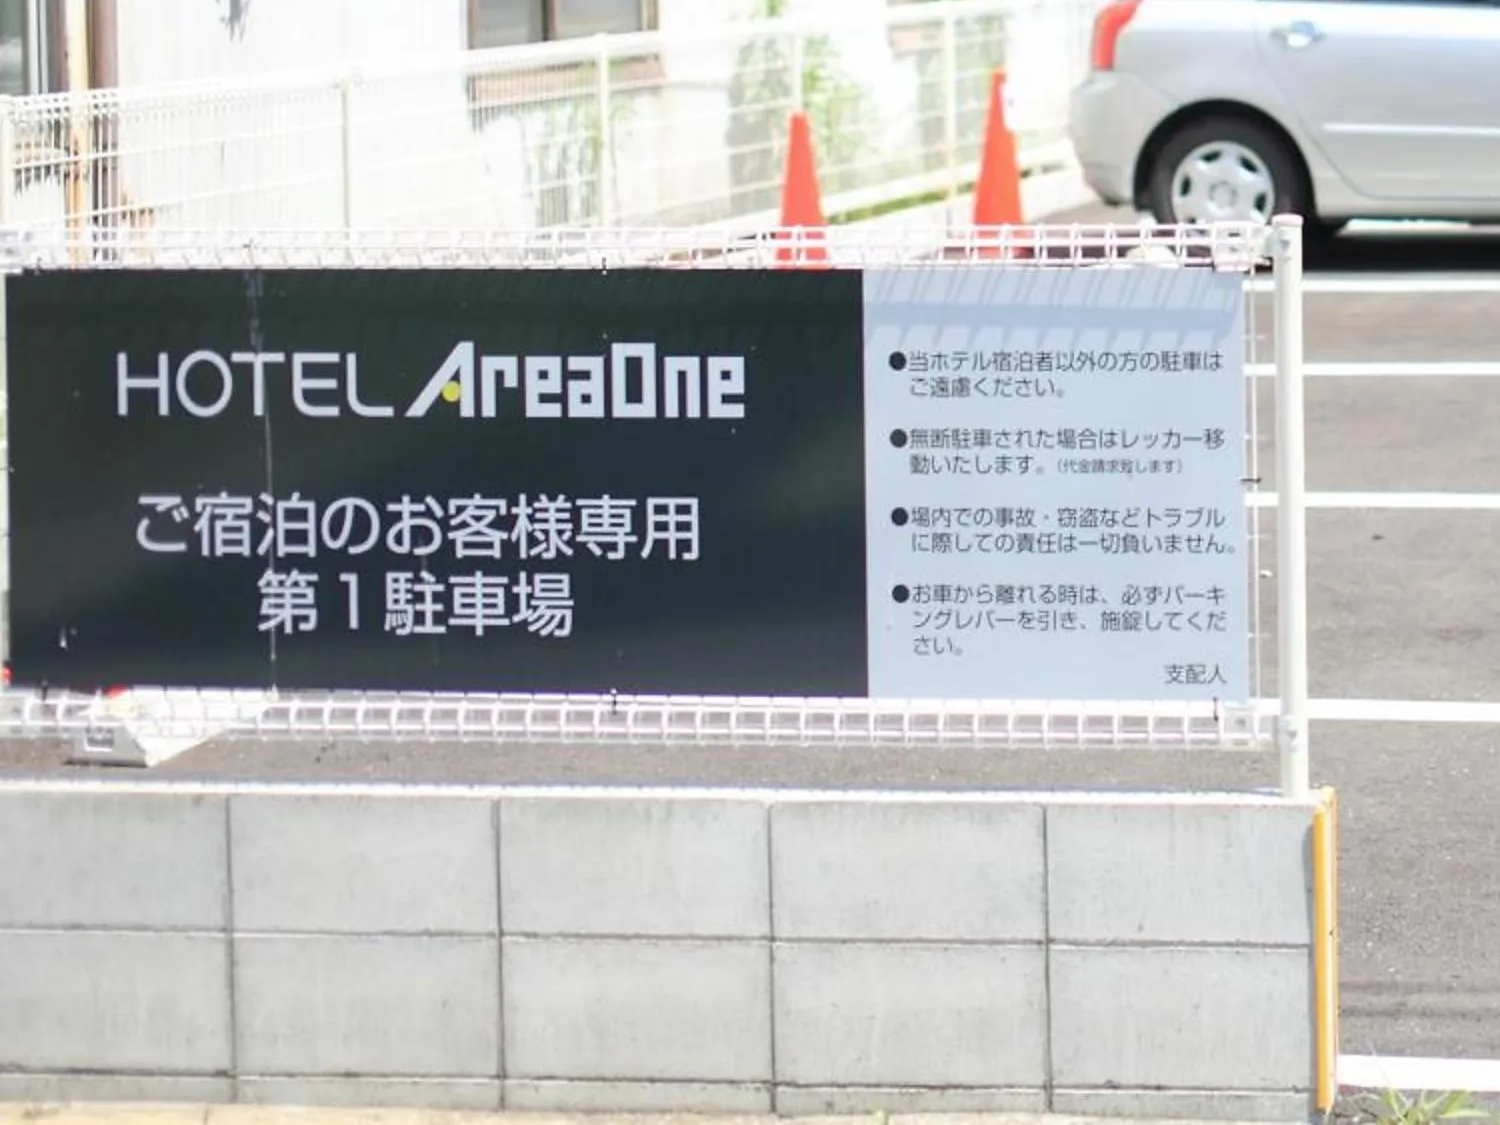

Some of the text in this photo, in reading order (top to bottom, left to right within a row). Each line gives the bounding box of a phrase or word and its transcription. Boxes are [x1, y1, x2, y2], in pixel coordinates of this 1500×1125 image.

[117, 341, 745, 419] HOTEL AreaOne
[136, 491, 701, 561] ご宿泊のお客様専用
[257, 569, 575, 638] 第1駐車場
[912, 634, 963, 656] さい。
[1163, 663, 1227, 685] 支配人
